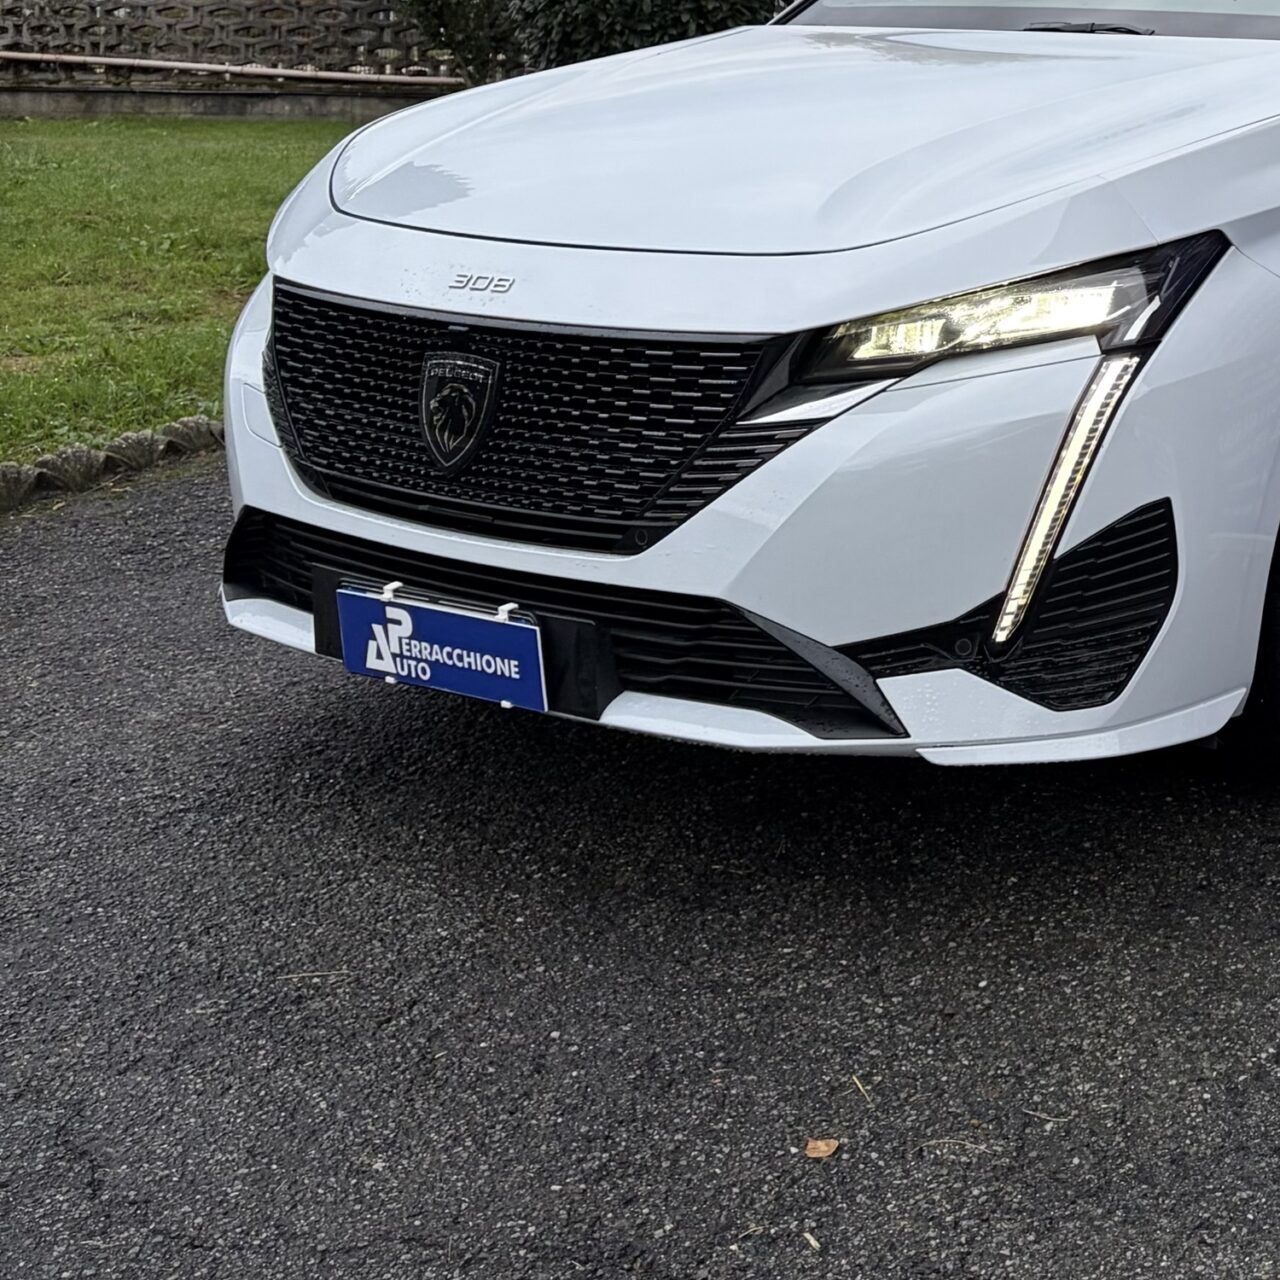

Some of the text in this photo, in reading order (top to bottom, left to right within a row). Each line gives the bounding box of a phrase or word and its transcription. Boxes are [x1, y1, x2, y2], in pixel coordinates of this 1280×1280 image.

[449, 273, 515, 294] 308
[366, 623, 431, 681] AUTO
[385, 606, 521, 679] PERRACCHIONE
